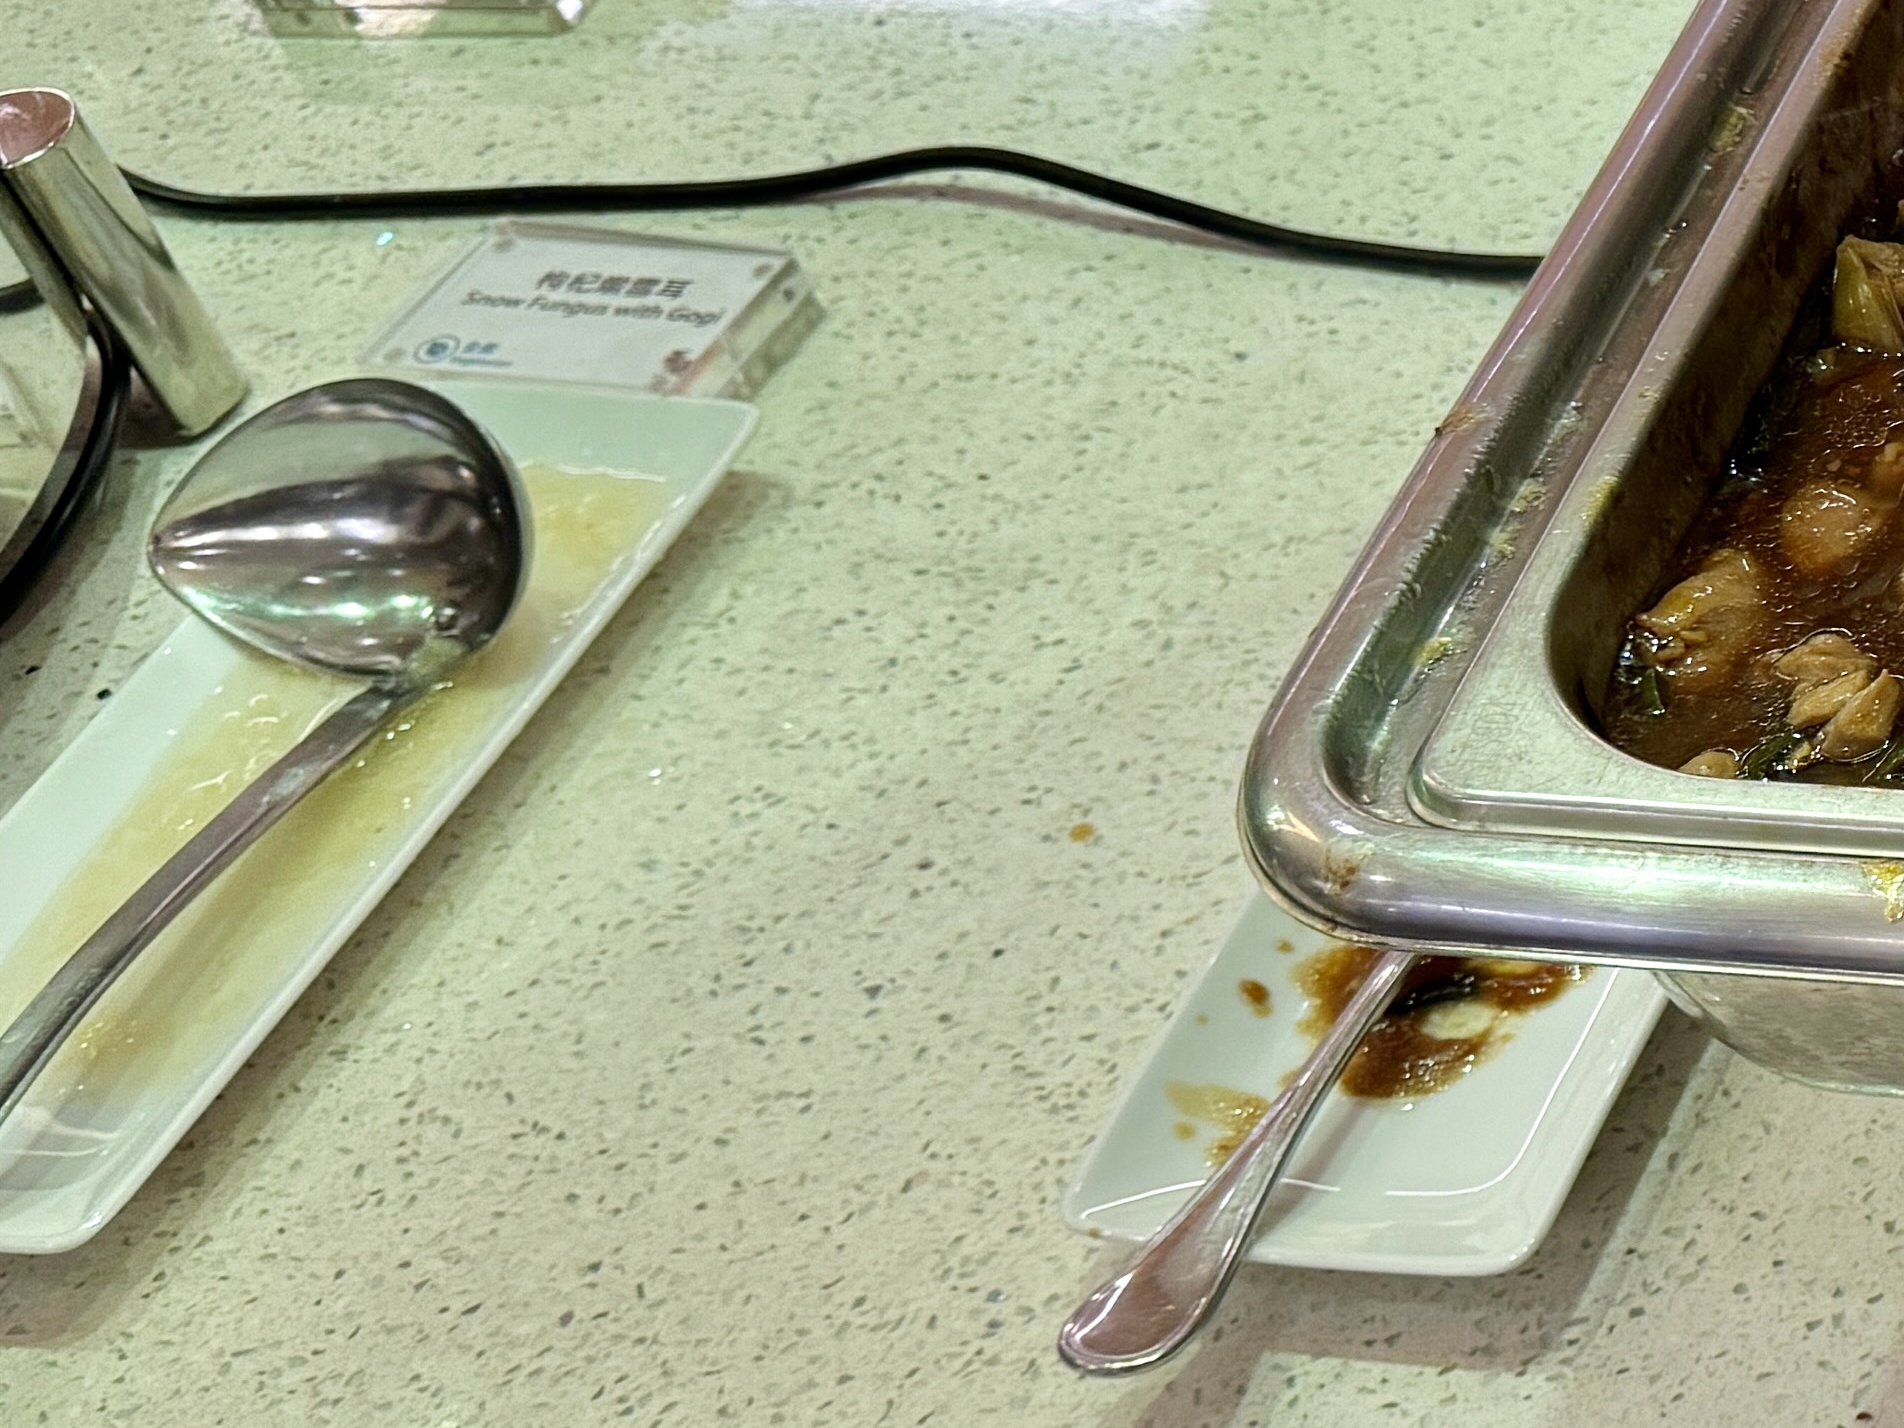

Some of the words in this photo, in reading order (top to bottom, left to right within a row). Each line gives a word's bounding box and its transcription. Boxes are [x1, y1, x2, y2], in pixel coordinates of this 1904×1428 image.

[460, 290, 526, 308] Snow
[527, 294, 609, 318] Fungus
[612, 306, 663, 320] with
